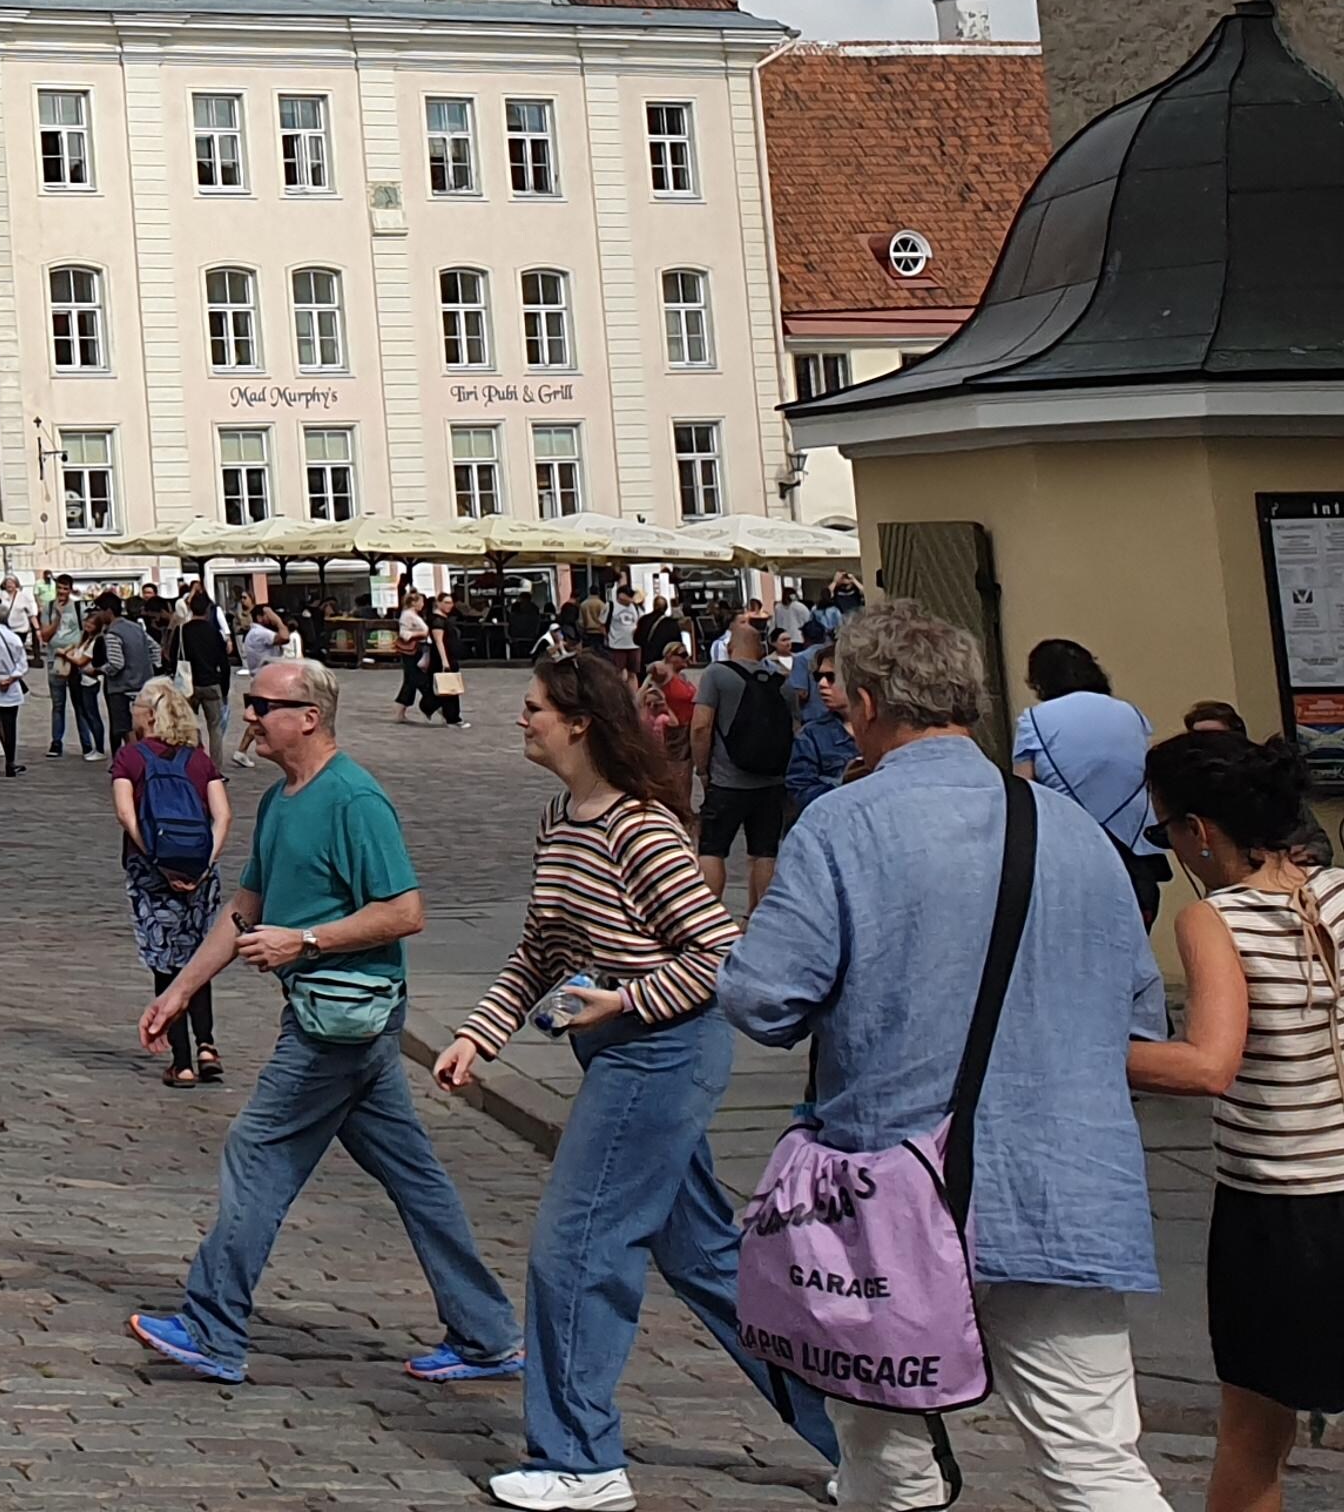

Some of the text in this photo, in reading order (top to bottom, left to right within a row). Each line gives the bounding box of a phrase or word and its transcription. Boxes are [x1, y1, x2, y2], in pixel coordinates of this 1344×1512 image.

[230, 386, 338, 409] Mad Murphy's
[482, 384, 519, 408] Pubi
[523, 384, 536, 403] &
[538, 384, 574, 404] Grill
[789, 1264, 892, 1299] GARAGE
[802, 1342, 941, 1388] LUGGAGE
